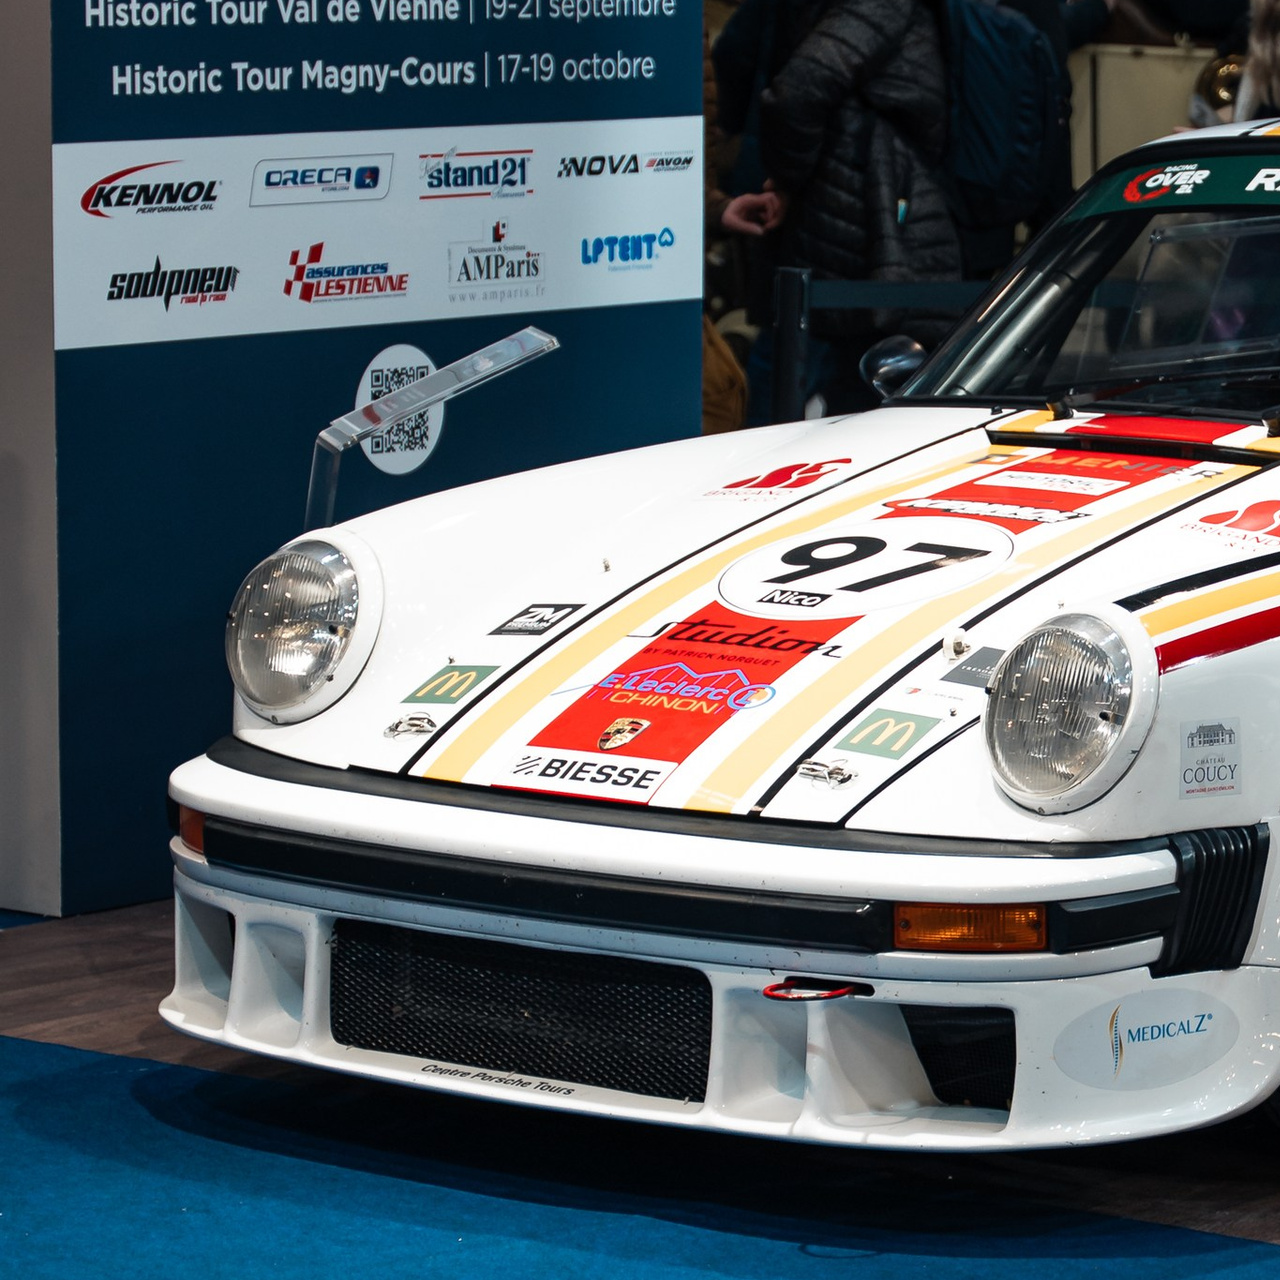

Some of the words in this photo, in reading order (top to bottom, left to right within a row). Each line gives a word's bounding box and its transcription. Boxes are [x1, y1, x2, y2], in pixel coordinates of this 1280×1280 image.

[111, 62, 222, 95] Historic
[231, 62, 292, 92] Tour
[302, 55, 476, 95] Magny-Cours
[498, 53, 554, 83] 17-19
[561, 51, 656, 81] octobre
[654, 156, 693, 167] AVON
[264, 166, 351, 188] ORECA
[1145, 169, 1211, 187] OVER
[89, 180, 218, 209] KENNOL
[136, 204, 198, 215] PERFORMANCE
[200, 203, 214, 211] OIL
[306, 262, 388, 279] assurances
[314, 274, 408, 297] LESTIENNE
[762, 536, 993, 593] 97
[762, 589, 822, 608] Nico
[665, 648, 713, 661] PATRICK
[716, 654, 781, 667] NORGUET
[610, 691, 721, 715] CHINON
[538, 758, 661, 790] BIESSE
[1183, 764, 1238, 785] COUCY
[421, 1062, 468, 1079] Centre
[470, 1072, 531, 1091] Porsche
[533, 1080, 576, 1097] Tours
